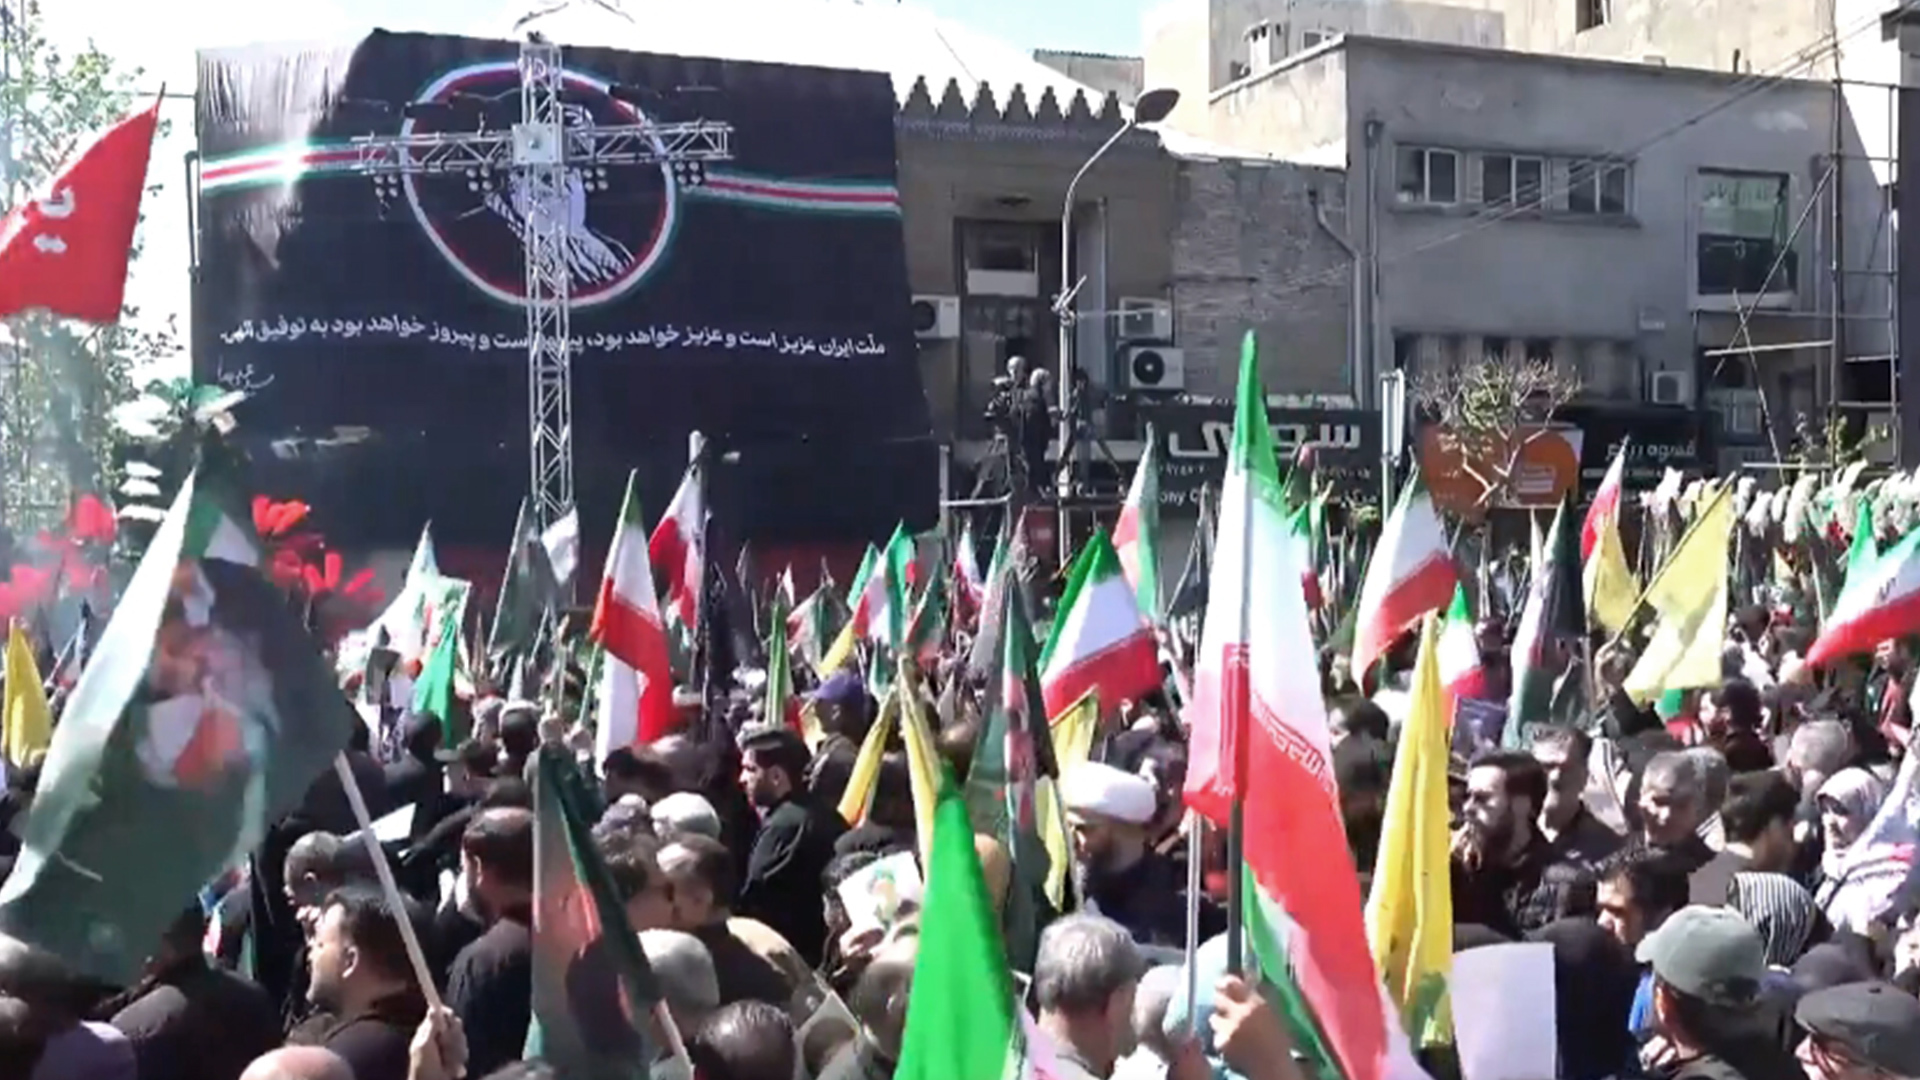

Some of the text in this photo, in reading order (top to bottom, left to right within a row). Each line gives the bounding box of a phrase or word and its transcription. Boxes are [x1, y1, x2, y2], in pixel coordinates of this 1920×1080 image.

[254, 314, 307, 343] توفیق
[309, 318, 328, 338] به
[331, 319, 364, 338] بود
[366, 314, 426, 338] خواهد
[428, 321, 476, 351] پیروز
[478, 333, 491, 351] و
[625, 324, 680, 349] خواهد
[681, 326, 722, 347] عزیز
[724, 333, 737, 348] و
[739, 332, 778, 348] است
[779, 336, 816, 355] عزیز
[818, 337, 855, 358] ایران
